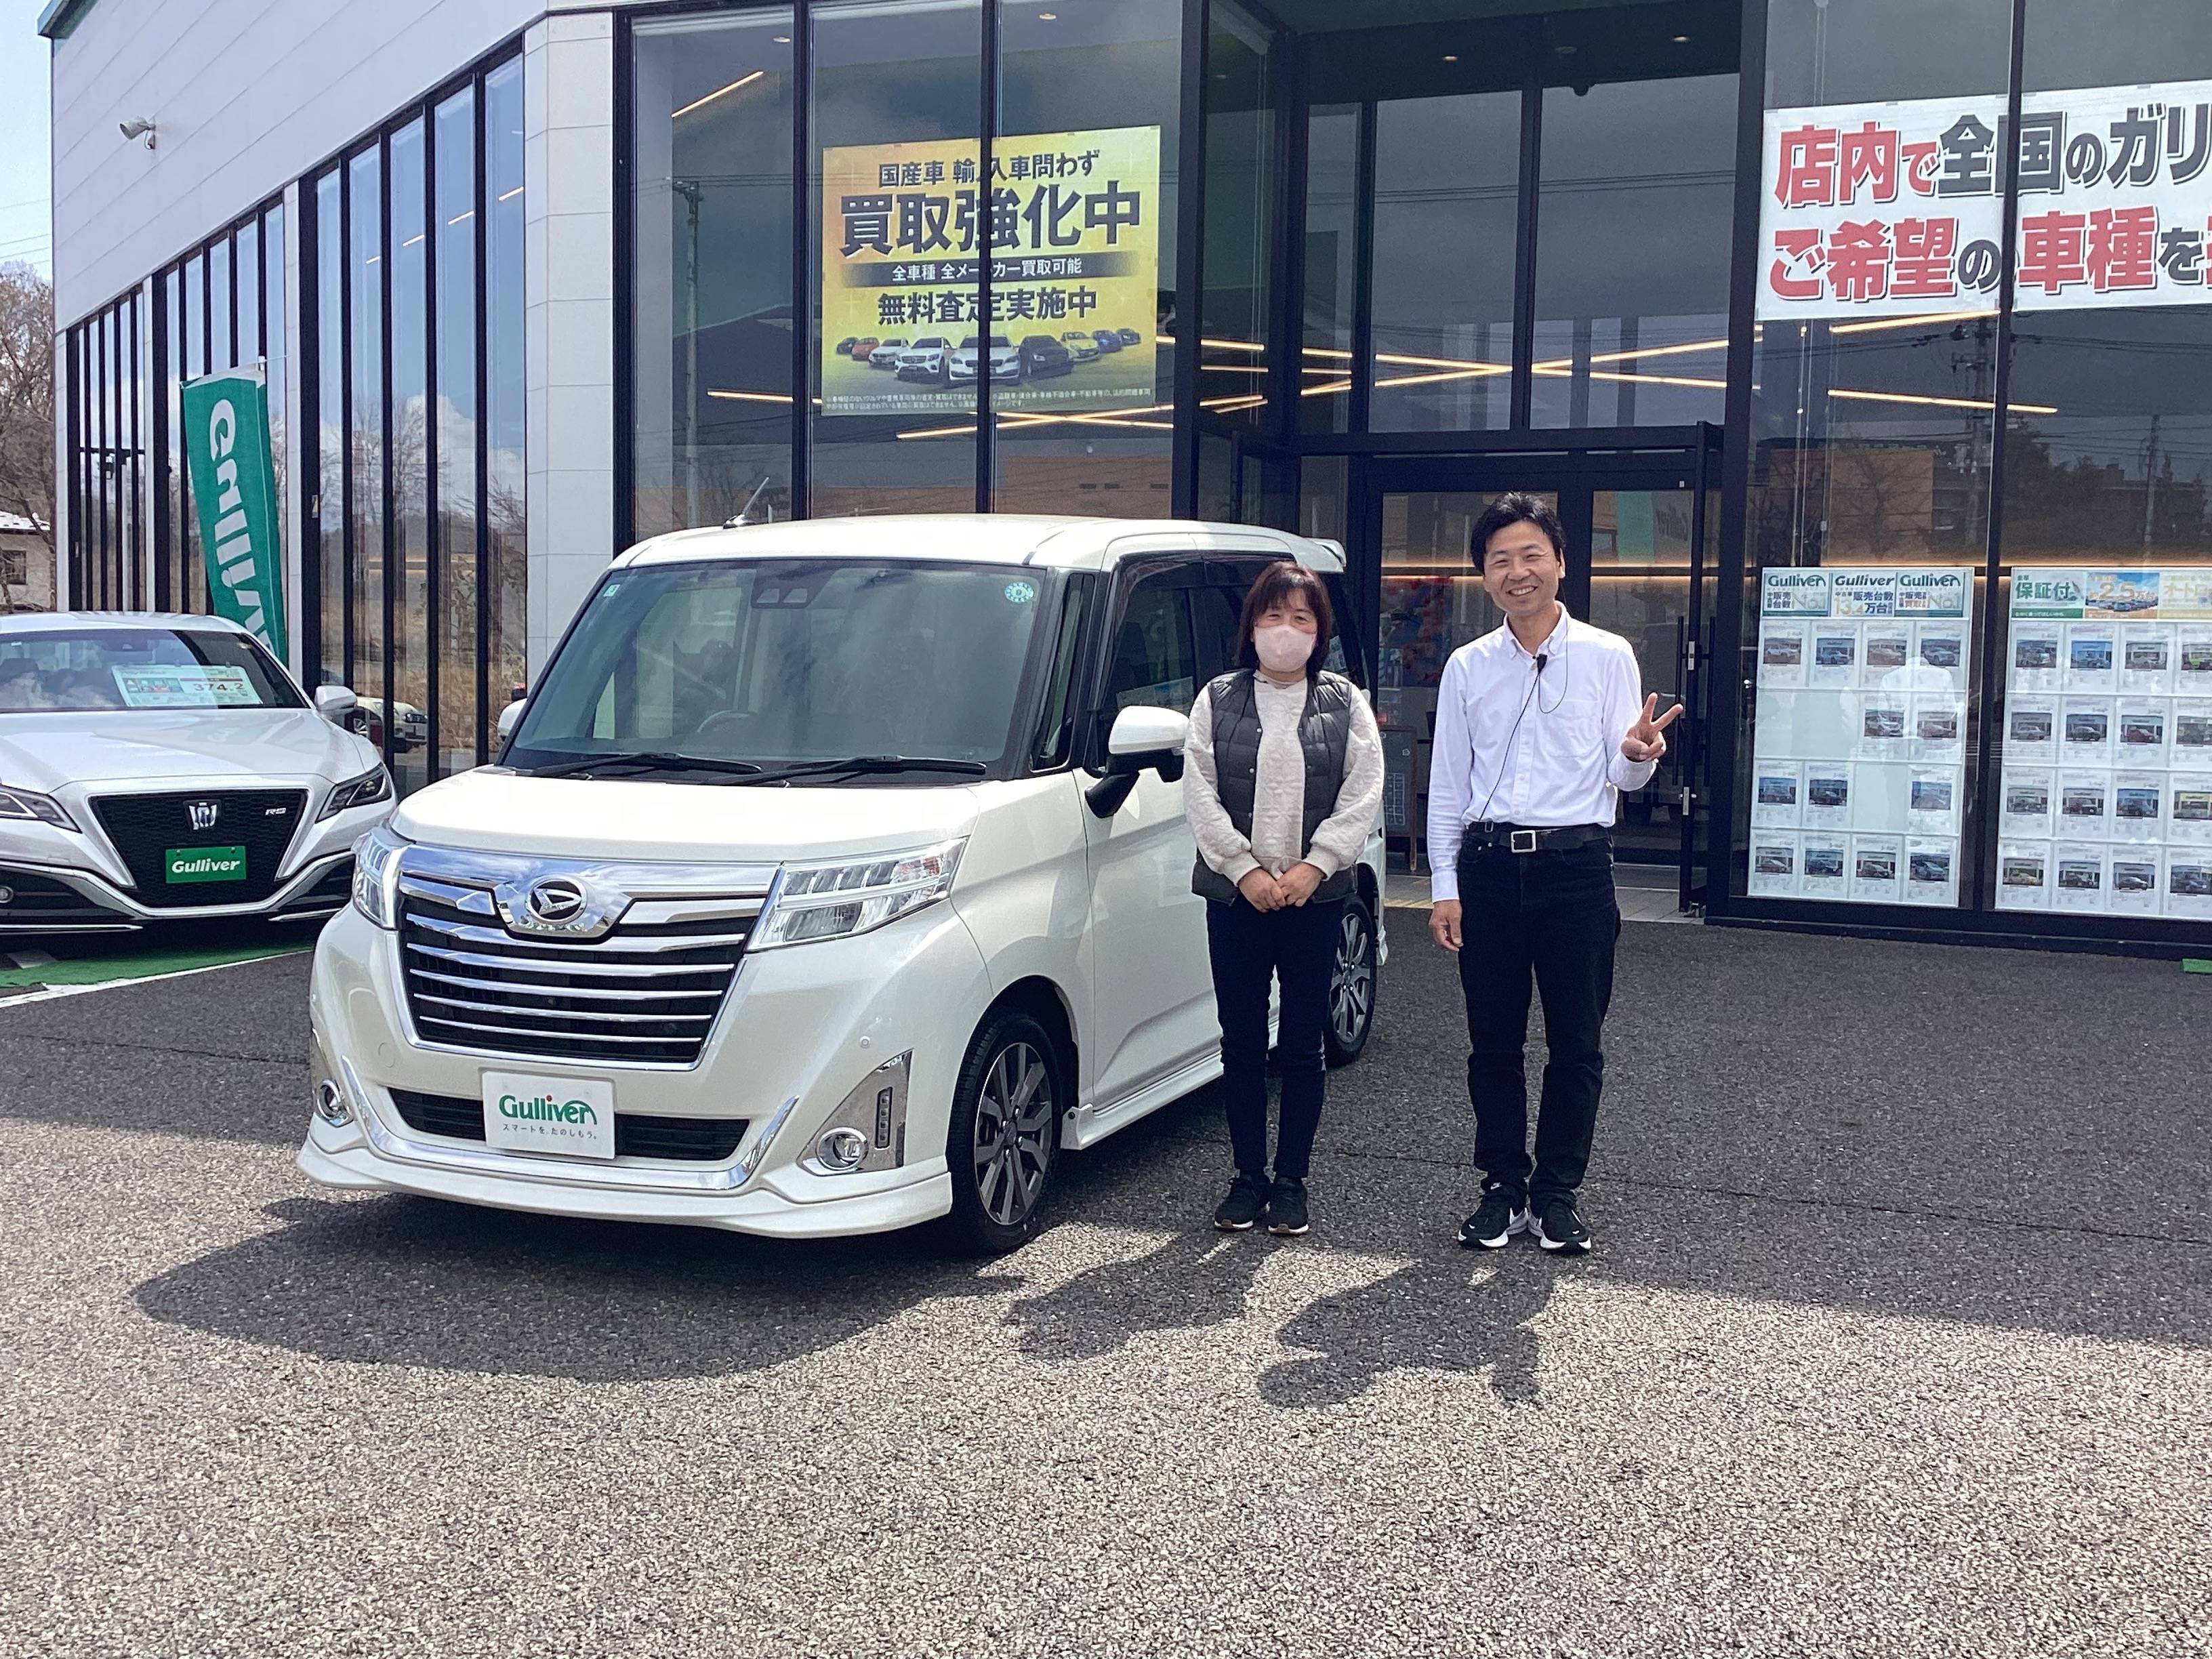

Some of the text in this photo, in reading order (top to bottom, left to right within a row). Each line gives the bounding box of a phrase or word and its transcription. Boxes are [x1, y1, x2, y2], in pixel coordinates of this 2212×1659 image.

[839, 180, 1141, 258] 買取強化中
[1769, 205, 2212, 303] ご希望の車種を
[878, 285, 1097, 325] 無料査定実施中
[1767, 573, 1826, 587] Gulliver
[1835, 574, 1895, 586] Gulliver
[1900, 573, 1961, 587] Gulliver
[265, 807, 287, 816] RS
[171, 858, 241, 874] Gulliver
[498, 1094, 598, 1126] Gulliver
